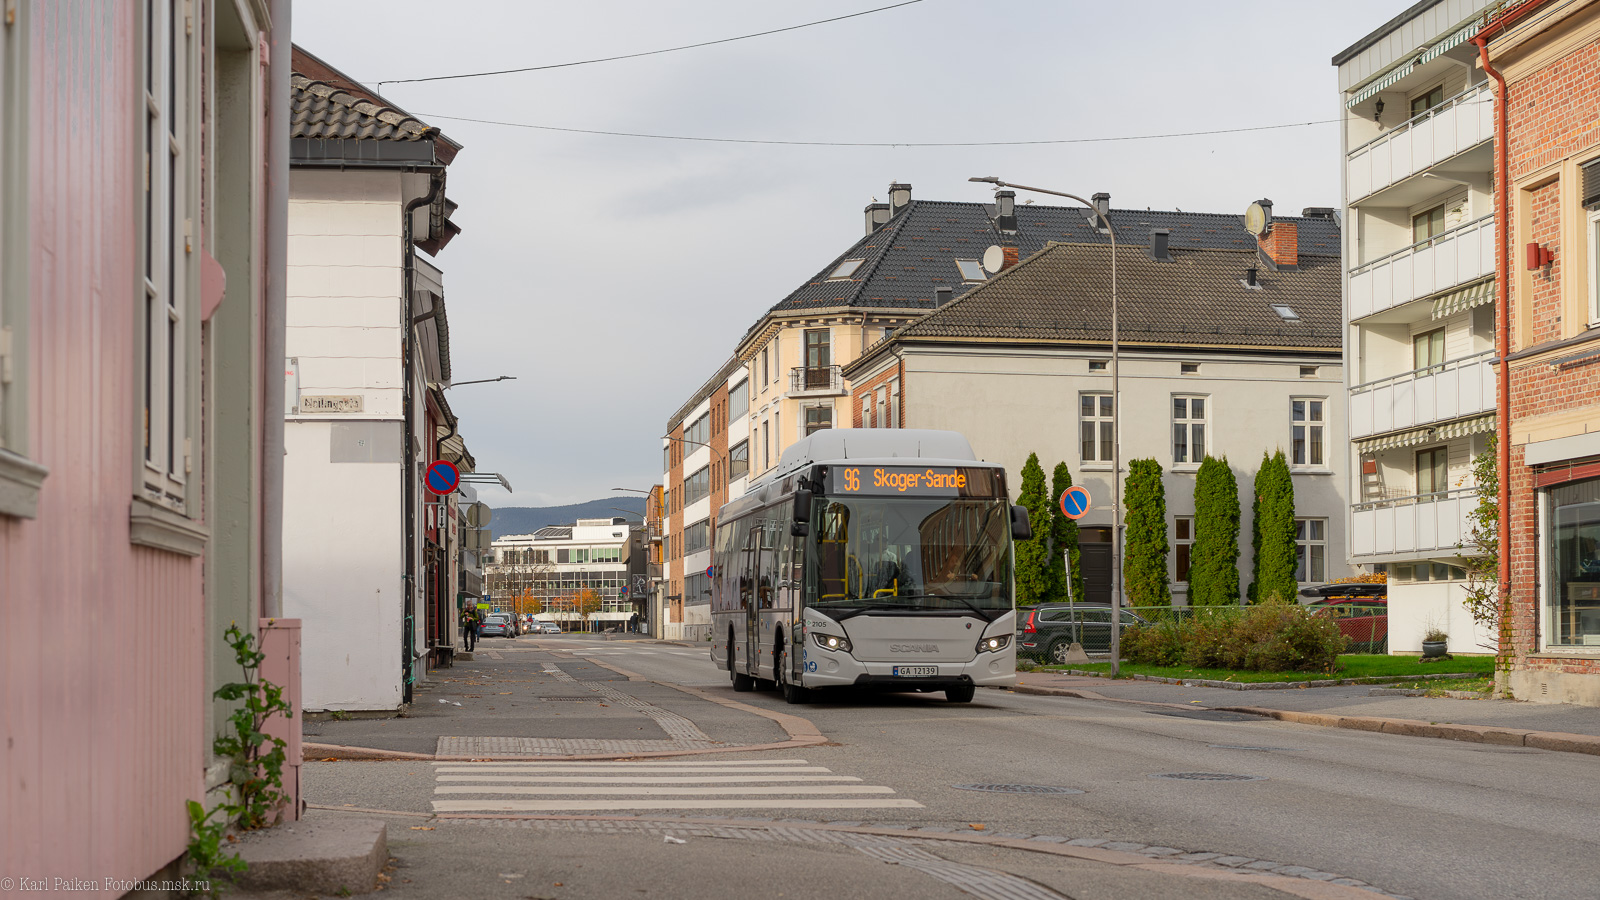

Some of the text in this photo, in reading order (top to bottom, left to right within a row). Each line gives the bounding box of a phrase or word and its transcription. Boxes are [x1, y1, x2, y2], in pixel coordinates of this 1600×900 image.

[844, 468, 966, 492] 96 Skoger-Sande
[889, 644, 940, 653] SCANIA
[900, 667, 935, 675] GA 12139
